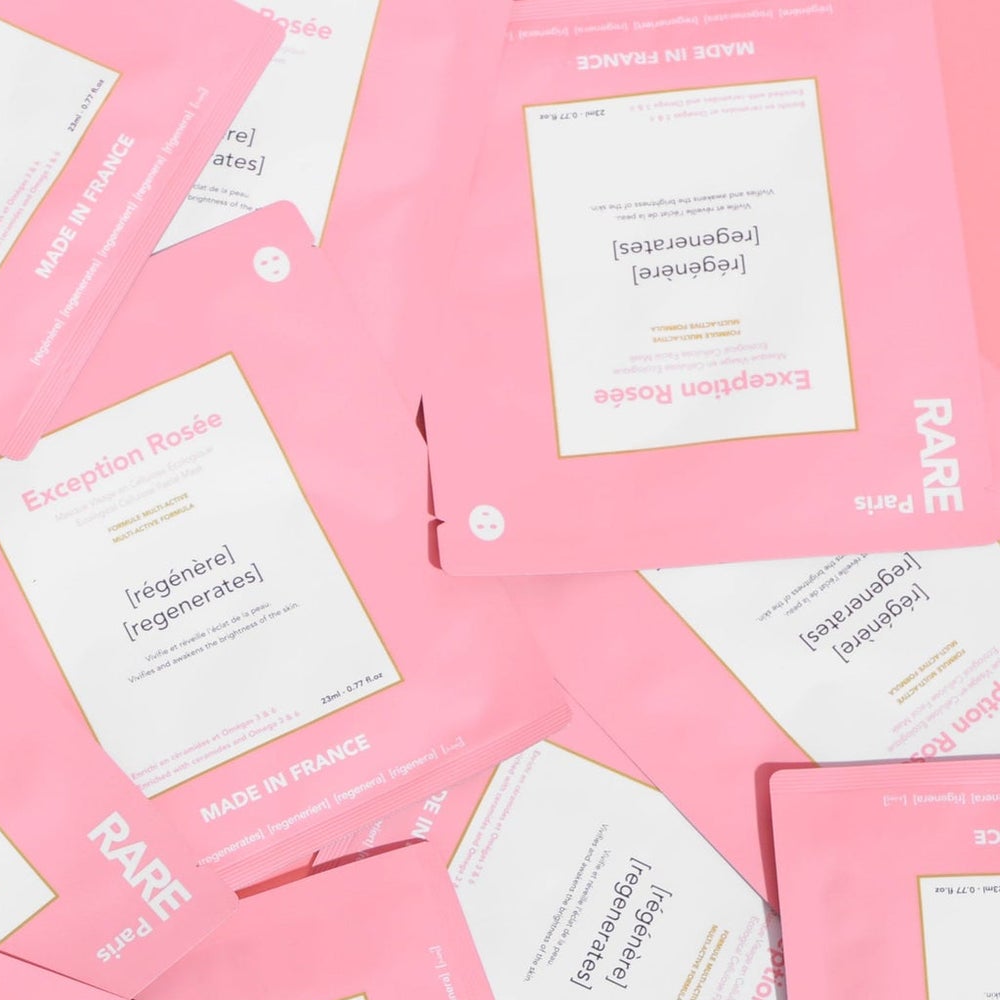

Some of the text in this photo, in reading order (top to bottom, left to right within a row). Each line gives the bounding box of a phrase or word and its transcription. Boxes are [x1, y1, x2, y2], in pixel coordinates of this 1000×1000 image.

[575, 40, 755, 70] MADE IN FRANCE
[34, 132, 135, 279] MADE IN FRANCE
[611, 224, 759, 261] [regenerates]
[631, 253, 746, 286] [régénère]
[593, 368, 811, 408] Exception Rosée
[20, 413, 223, 512] Exception Rosée
[912, 397, 963, 513] RARE
[853, 493, 914, 515] Paris
[122, 562, 264, 642] [regenerates]
[124, 543, 236, 609] [régénère]
[799, 552, 922, 651] [regenerates]
[832, 583, 930, 663] [régénère]
[199, 733, 371, 823] MADE IN FRANCE
[86, 810, 192, 921] RARE
[95, 915, 152, 962] Paris
[569, 856, 651, 990] [regenerates]
[604, 884, 672, 989] [régénère]
